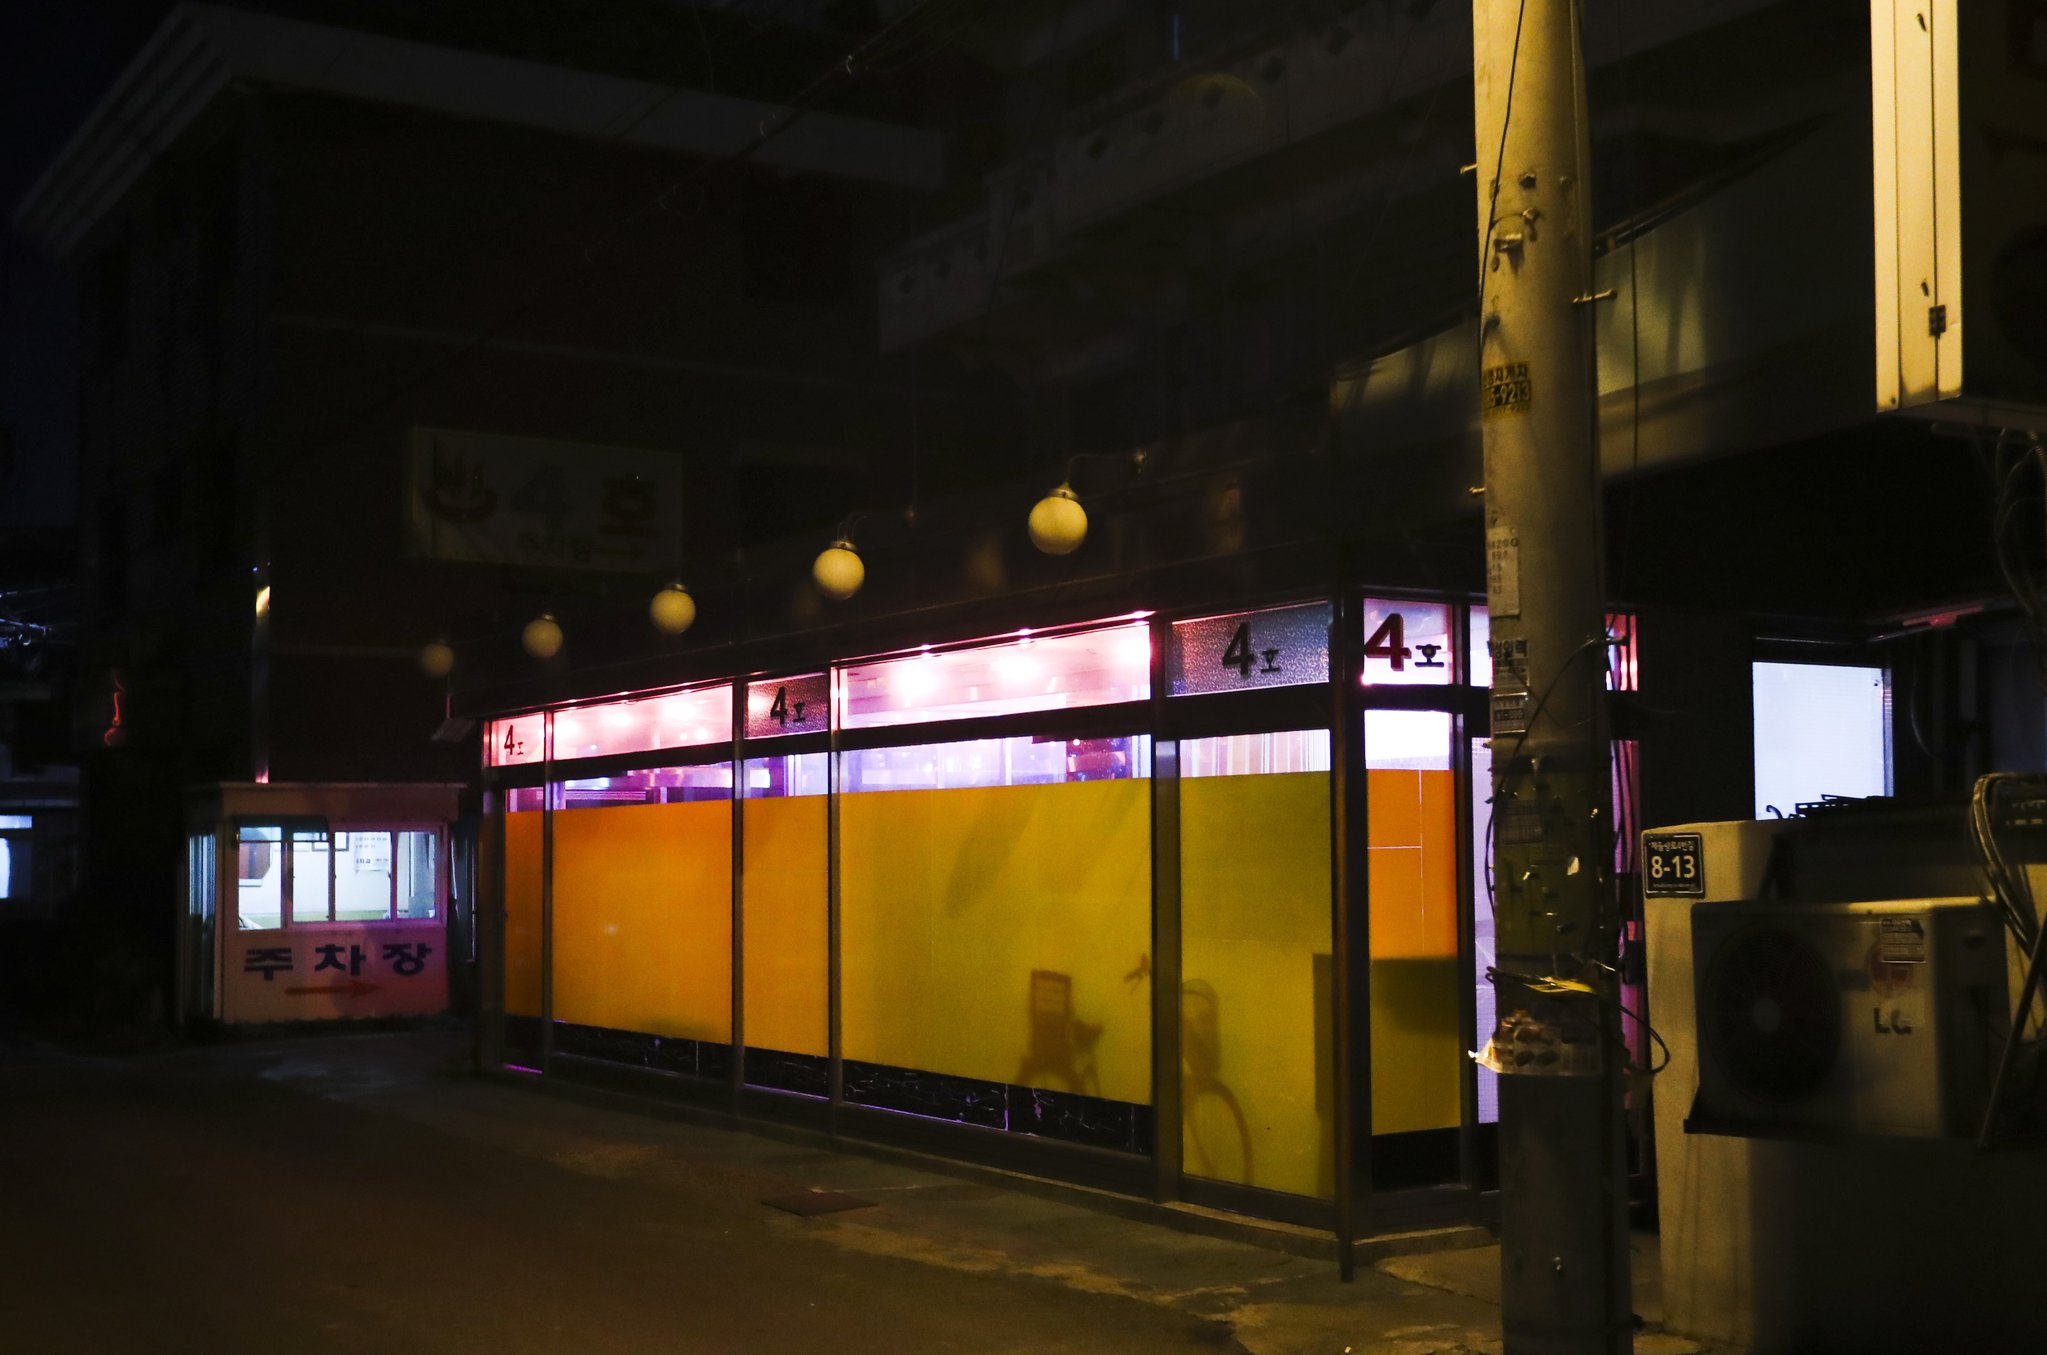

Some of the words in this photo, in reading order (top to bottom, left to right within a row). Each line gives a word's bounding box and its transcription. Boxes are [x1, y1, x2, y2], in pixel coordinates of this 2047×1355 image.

[1222, 622, 1280, 678] 4호
[1364, 613, 1445, 672] 4호
[769, 685, 806, 725] 4호
[1651, 855, 1696, 879] 8-13
[244, 943, 432, 981] 주차장
[1873, 1007, 1913, 1034] LG
